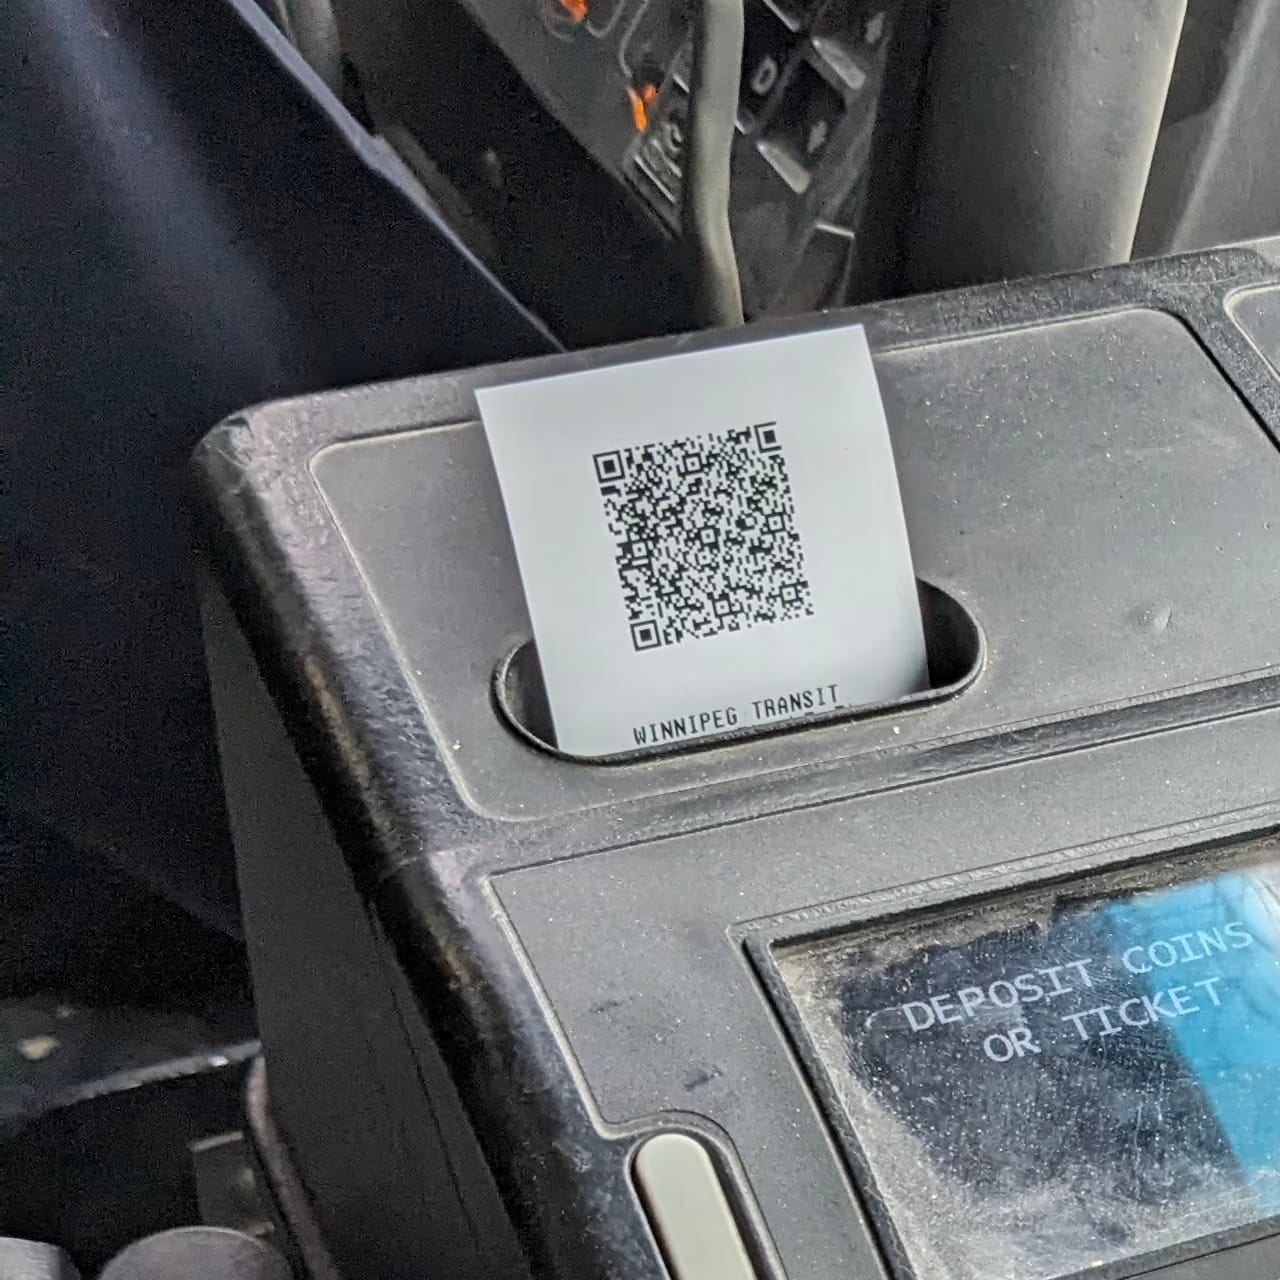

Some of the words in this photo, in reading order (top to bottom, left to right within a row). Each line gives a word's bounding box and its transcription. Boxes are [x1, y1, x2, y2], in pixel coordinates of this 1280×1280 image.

[633, 707, 738, 745] WINNIPEG
[751, 685, 838, 720] TRANSIT
[902, 957, 1094, 1032] DEPOSIT
[1122, 921, 1255, 975] COINS
[982, 1026, 1042, 1064] OR
[1062, 976, 1222, 1042] TICKET
